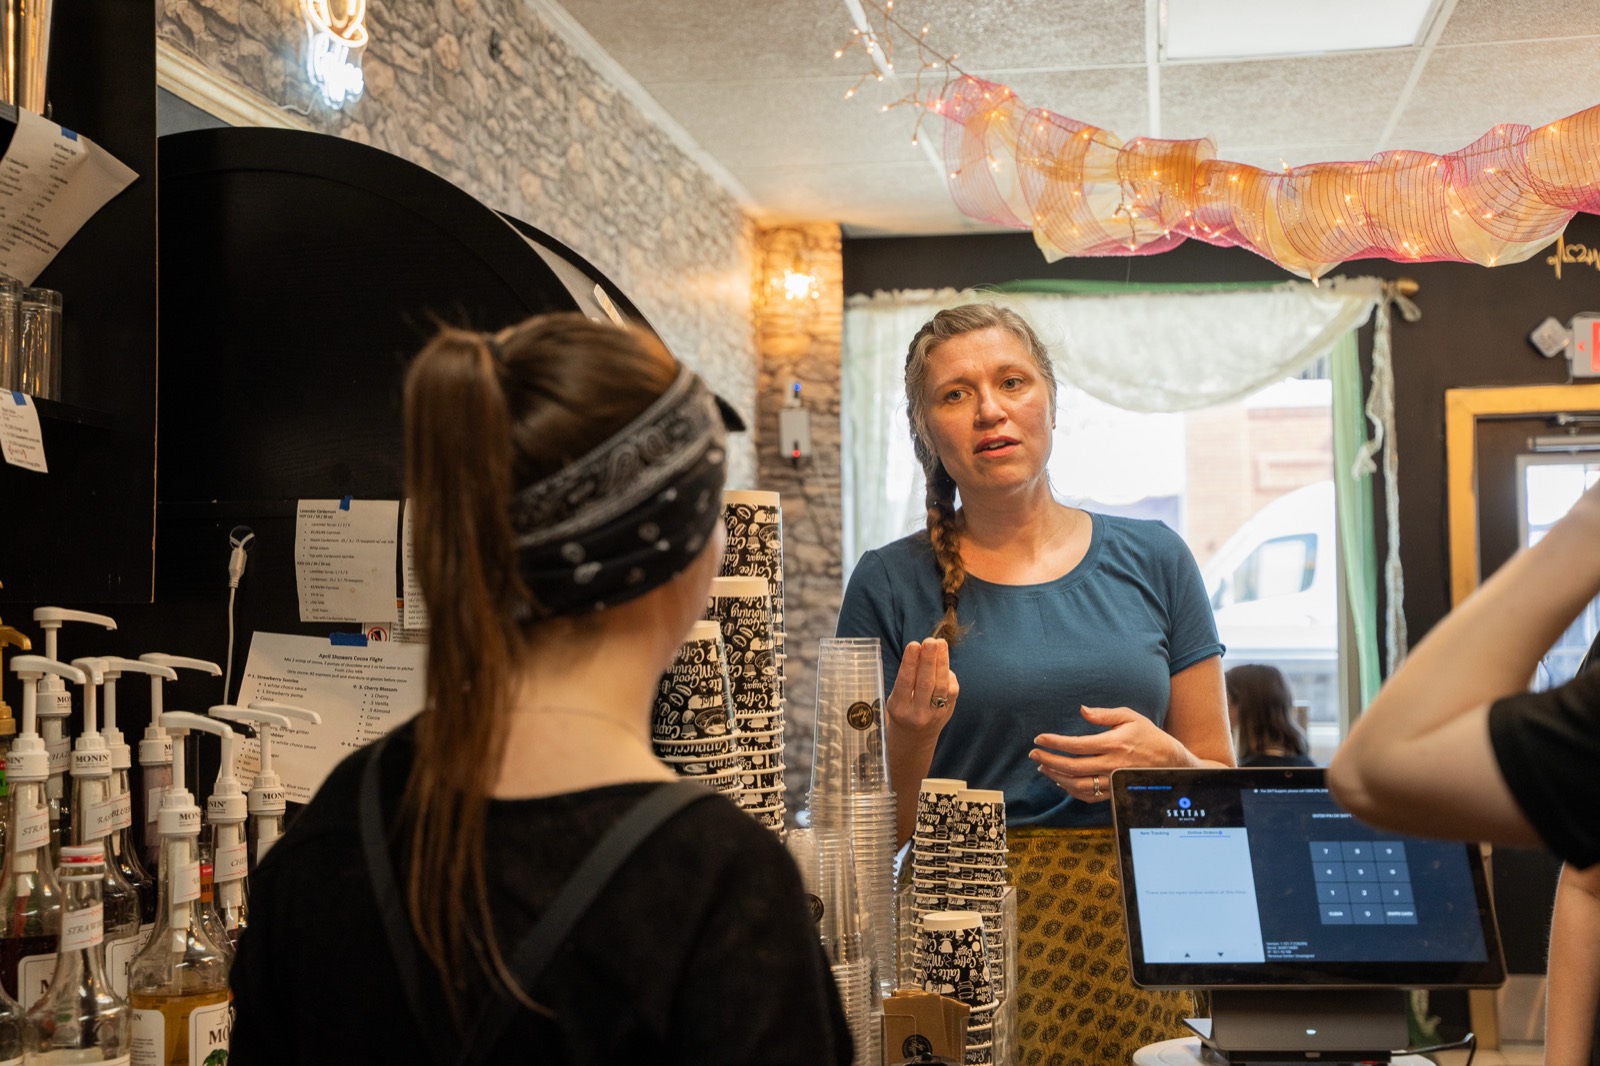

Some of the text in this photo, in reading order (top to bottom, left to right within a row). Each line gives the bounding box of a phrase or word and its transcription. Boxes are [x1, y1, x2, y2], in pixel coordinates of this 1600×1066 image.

[746, 551, 772, 566] Sugar
[739, 563, 772, 580] Coffee
[730, 602, 768, 623] Morning
[736, 617, 760, 632] Good
[672, 673, 700, 689] Good
[742, 679, 768, 693] Sugar
[700, 698, 714, 708] Hot
[735, 690, 769, 709] Coffee
[75, 754, 108, 763] MONIN
[22, 823, 48, 836] STRAW
[953, 955, 977, 969] Coffee
[937, 968, 960, 982] latte
